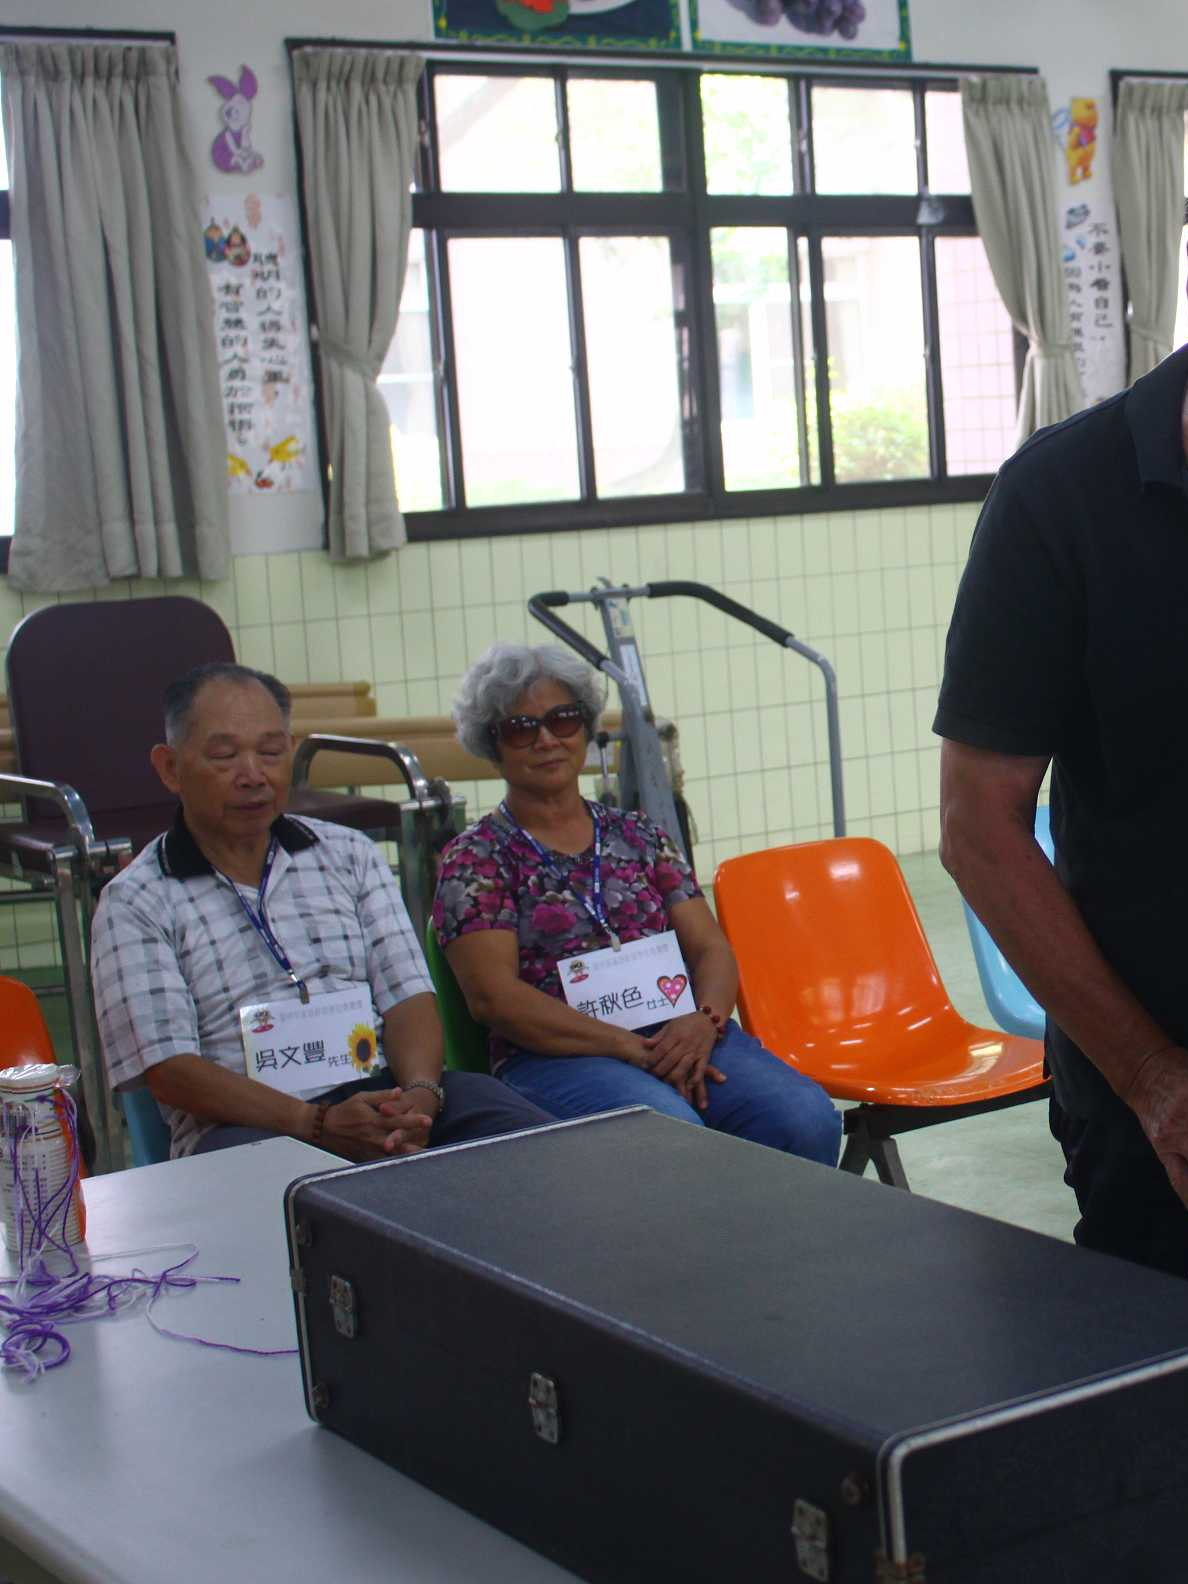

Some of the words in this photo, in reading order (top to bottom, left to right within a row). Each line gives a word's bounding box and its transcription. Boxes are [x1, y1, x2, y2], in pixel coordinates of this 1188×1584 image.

[576, 986, 645, 1019] 許秋色
[256, 1039, 326, 1072] 吳文豐
[327, 1052, 353, 1068] 先生
